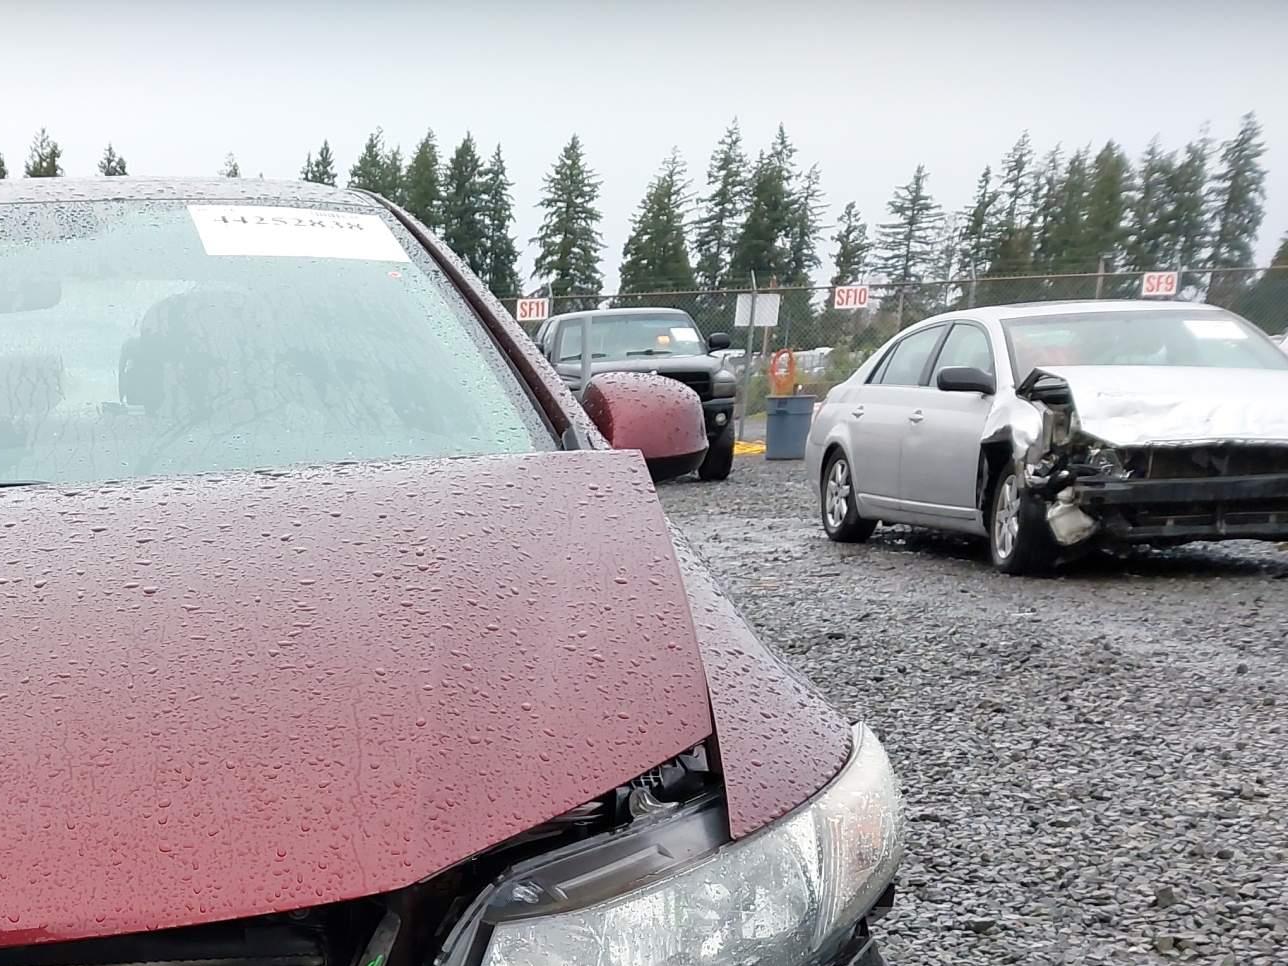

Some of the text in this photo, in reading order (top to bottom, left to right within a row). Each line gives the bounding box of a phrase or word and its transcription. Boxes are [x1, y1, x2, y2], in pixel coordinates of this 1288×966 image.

[1146, 274, 1174, 293] SF9
[837, 288, 867, 306] SF10
[520, 301, 545, 318] SF11
